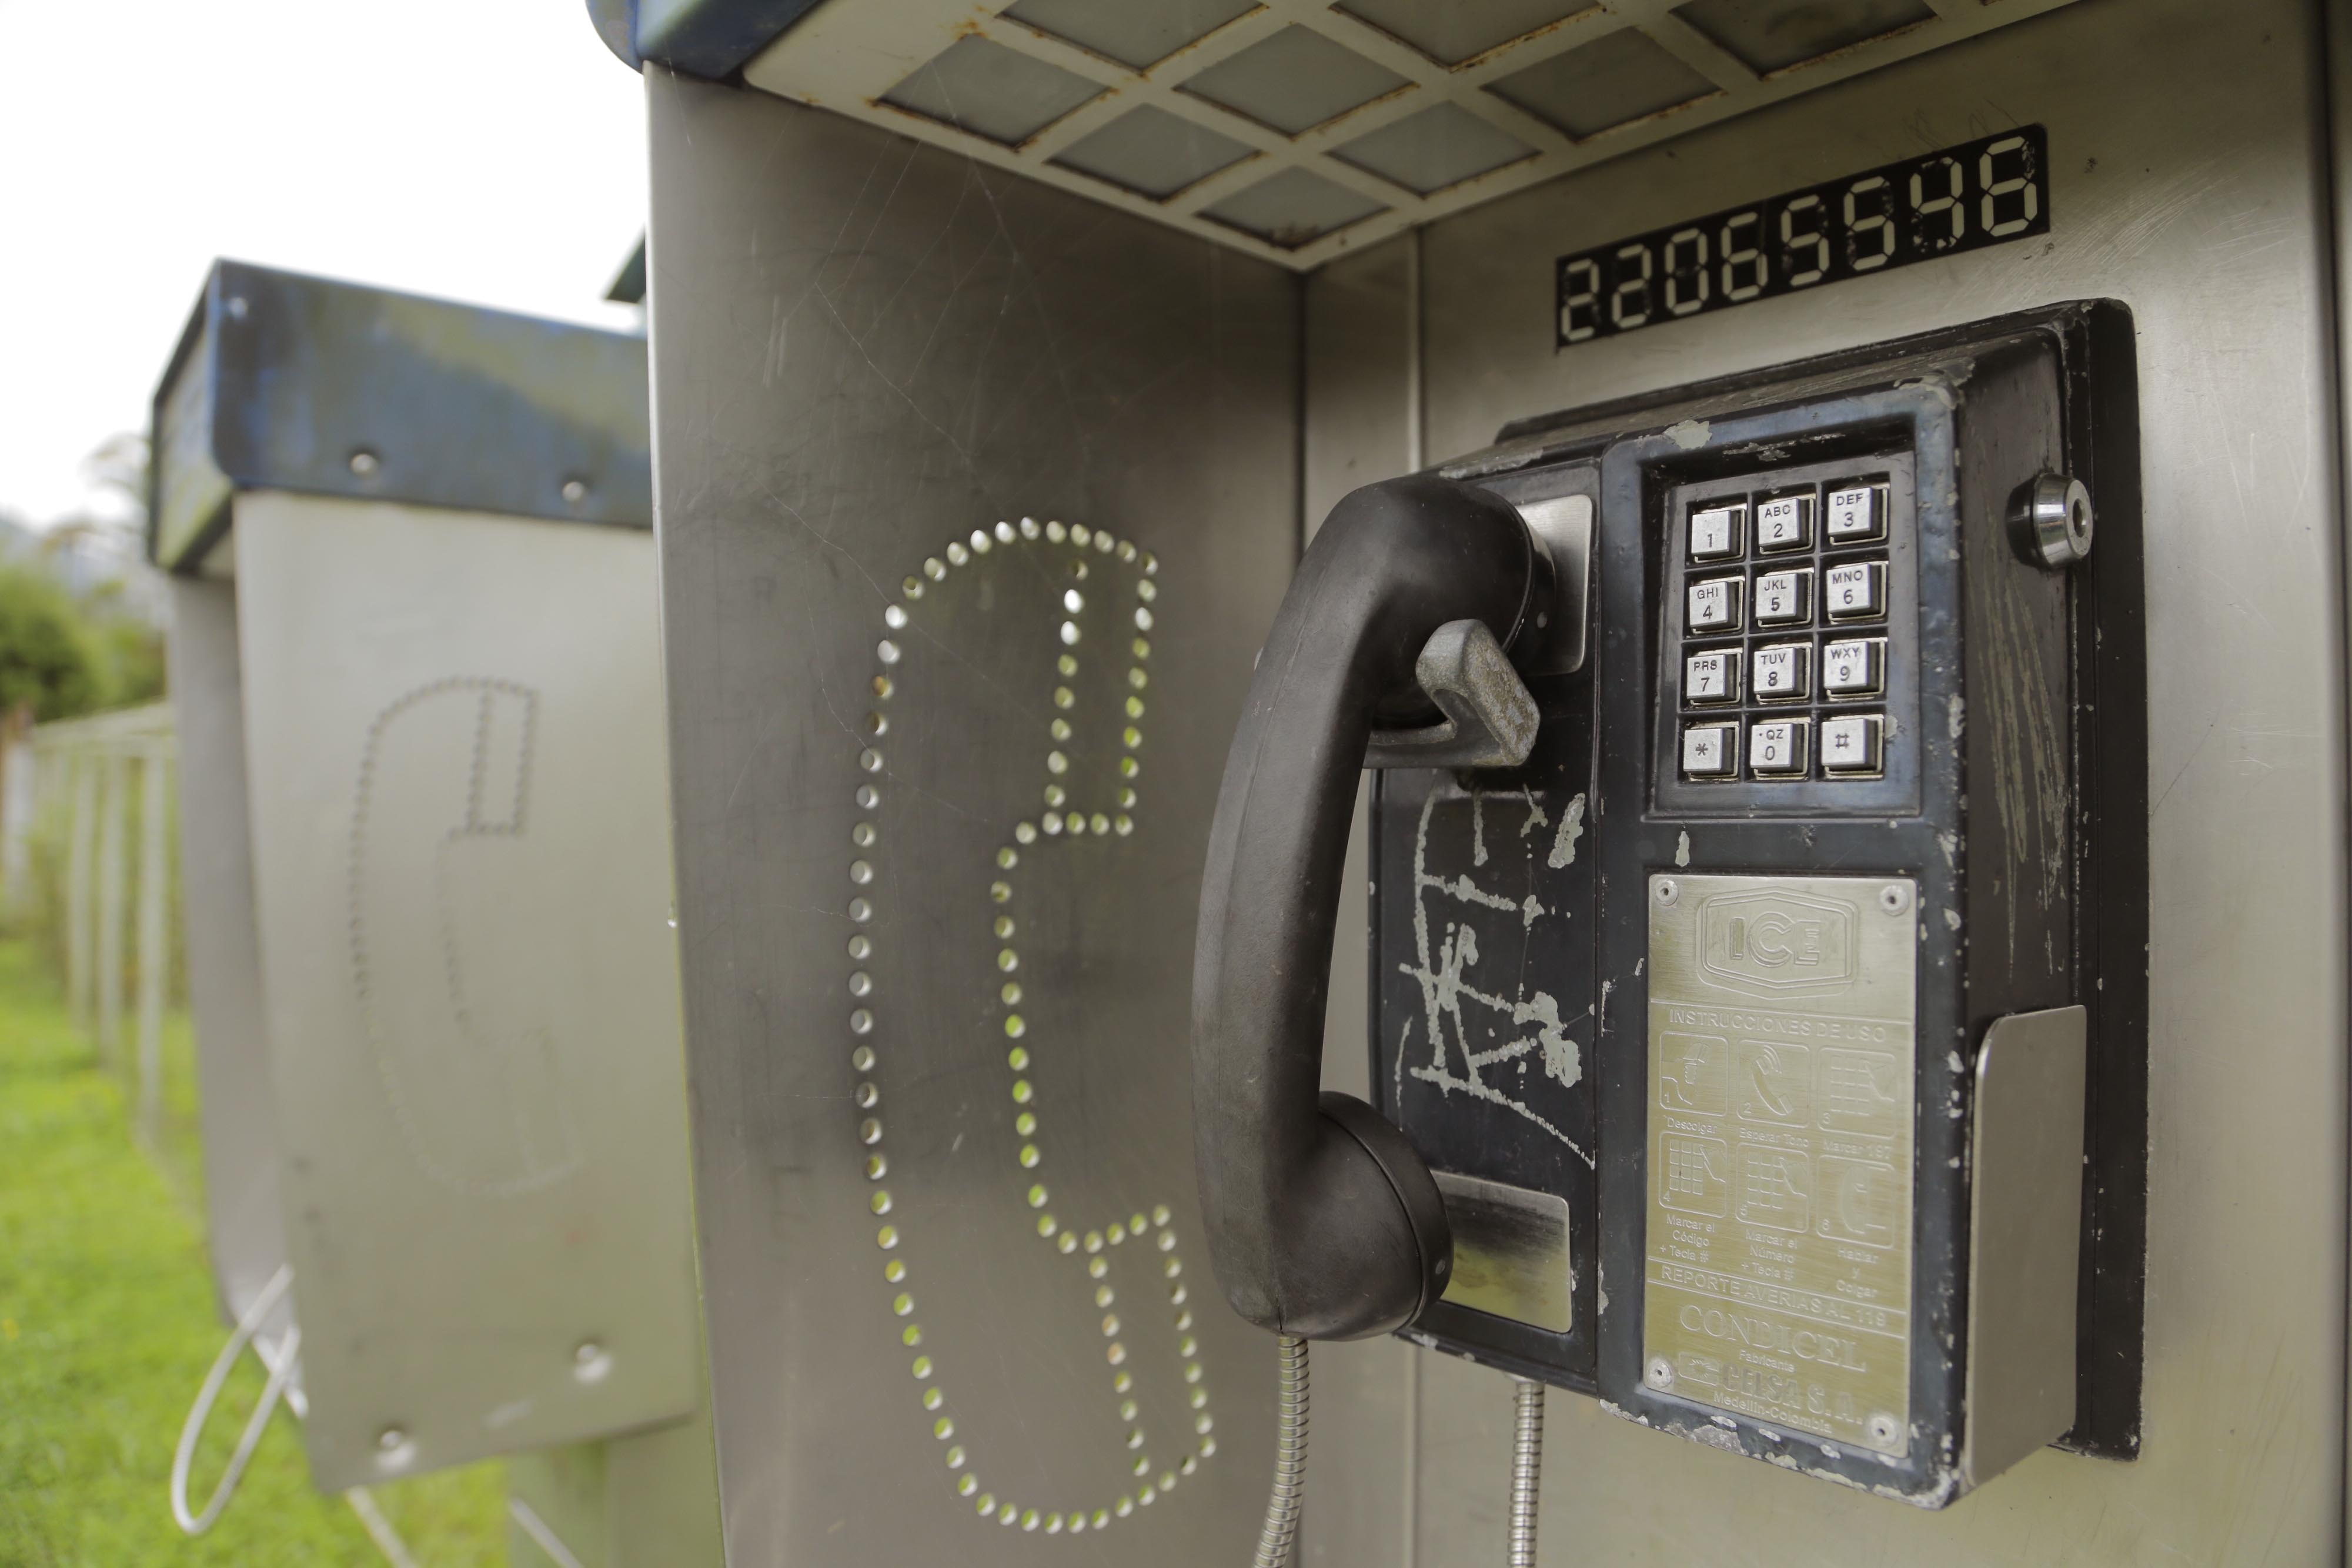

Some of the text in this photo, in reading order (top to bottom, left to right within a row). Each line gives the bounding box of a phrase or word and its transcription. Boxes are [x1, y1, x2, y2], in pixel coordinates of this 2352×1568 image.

[1836, 493, 1864, 506] DEF
[1765, 505, 1790, 518] ABC
[1843, 512, 1854, 527] 3
[1773, 523, 1783, 538] 2
[1707, 533, 1713, 548] 1
[1832, 570, 1863, 584] MNO
[1763, 579, 1788, 591] JKL
[1697, 587, 1718, 599] GHI
[1843, 590, 1853, 604] 6
[1770, 597, 1780, 611] 5
[1702, 605, 1713, 620] 4
[1760, 653, 1786, 665] TUV
[1830, 647, 1860, 659] WXY
[1693, 660, 1718, 672] PRS
[1840, 666, 1850, 681] 9
[1700, 677, 1710, 692] 7
[1768, 671, 1778, 687] 8
[1765, 745, 1775, 761] 0
[1730, 911, 1822, 968] ICE
[1669, 1008, 1886, 1043] INSTRUCCIONES DE USO
[1664, 1091, 1670, 1103] 1
[1743, 1102, 1752, 1114] 2
[1667, 1116, 1718, 1135] Descolgar
[1739, 1126, 1809, 1148] Esperar Tono
[1823, 1139, 1863, 1155] Marcar
[1663, 1190, 1671, 1202] 4
[1740, 1204, 1748, 1216] 5
[1666, 1213, 1715, 1233] Marcar el
[1822, 1218, 1830, 1231] 6
[1672, 1229, 1710, 1248] Código
[1745, 1228, 1798, 1249] Marcar el
[1669, 1245, 1696, 1261] Tecla
[1752, 1262, 1781, 1279] Tecla
[1662, 1265, 1740, 1296] REPORTE
[1743, 1285, 1822, 1313] AVERIAS
[1825, 1300, 1851, 1320] AL
[1836, 1279, 1878, 1299] Colgar
[1680, 1304, 1866, 1372] CONDICEL
[1738, 1349, 1795, 1373] Fabricante
